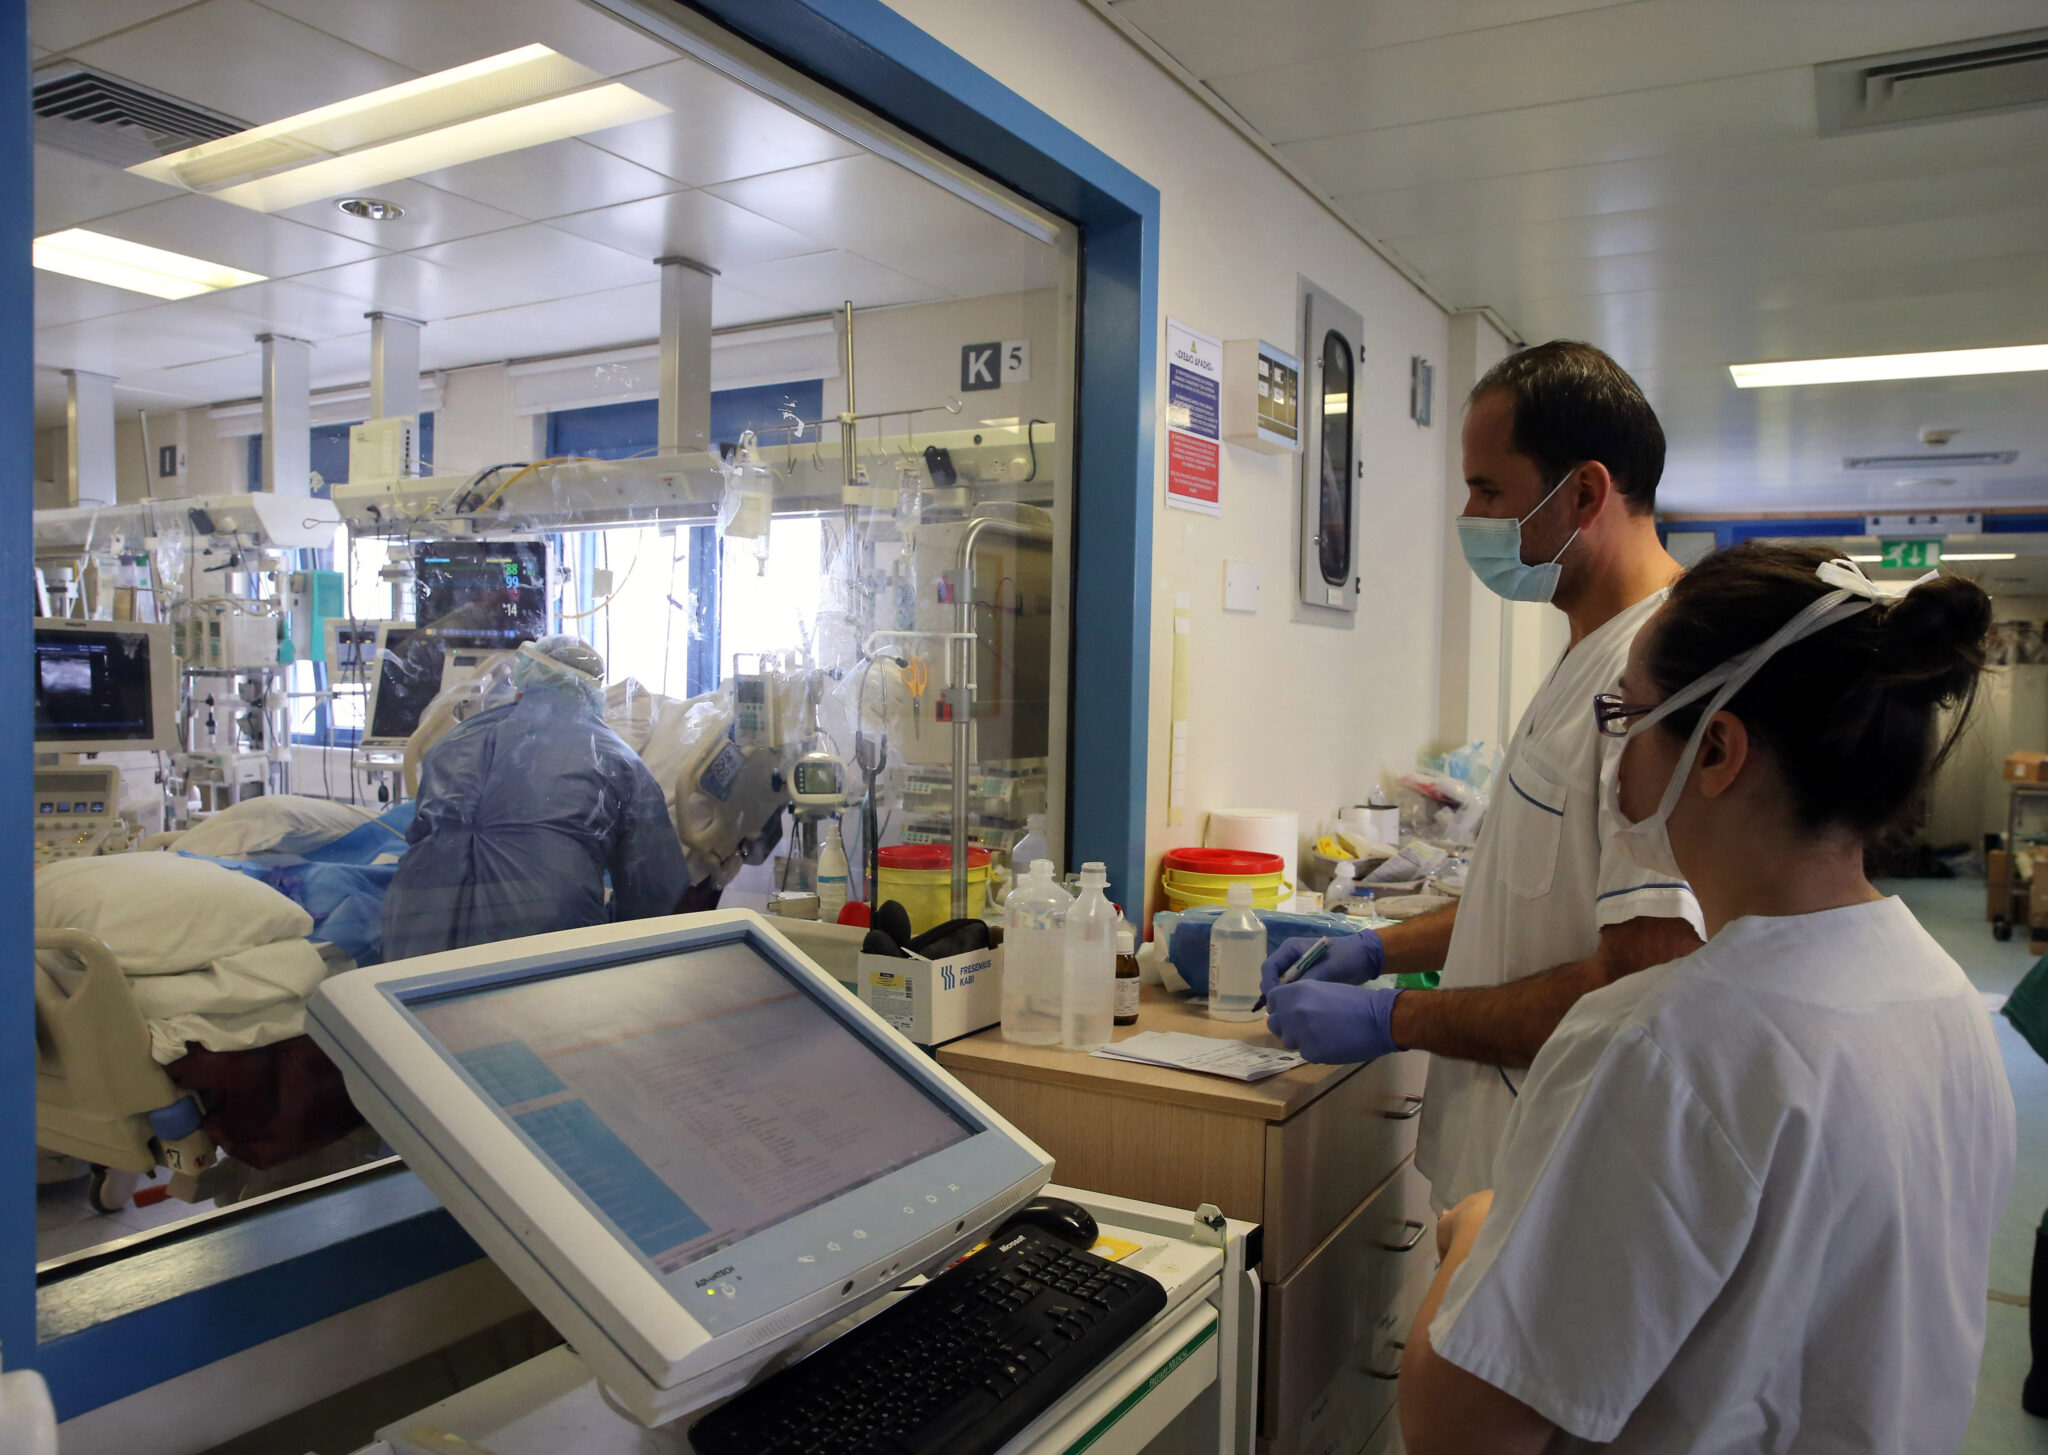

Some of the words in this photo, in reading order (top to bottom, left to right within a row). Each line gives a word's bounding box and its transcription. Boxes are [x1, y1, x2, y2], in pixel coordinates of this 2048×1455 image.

[968, 350, 993, 384] K
[1009, 346, 1022, 370] 5
[506, 563, 518, 575] 88
[506, 576, 519, 589] 99
[960, 960, 992, 976] FRESENIUS
[959, 975, 975, 987] KABI
[998, 1235, 1026, 1252] Microsoft
